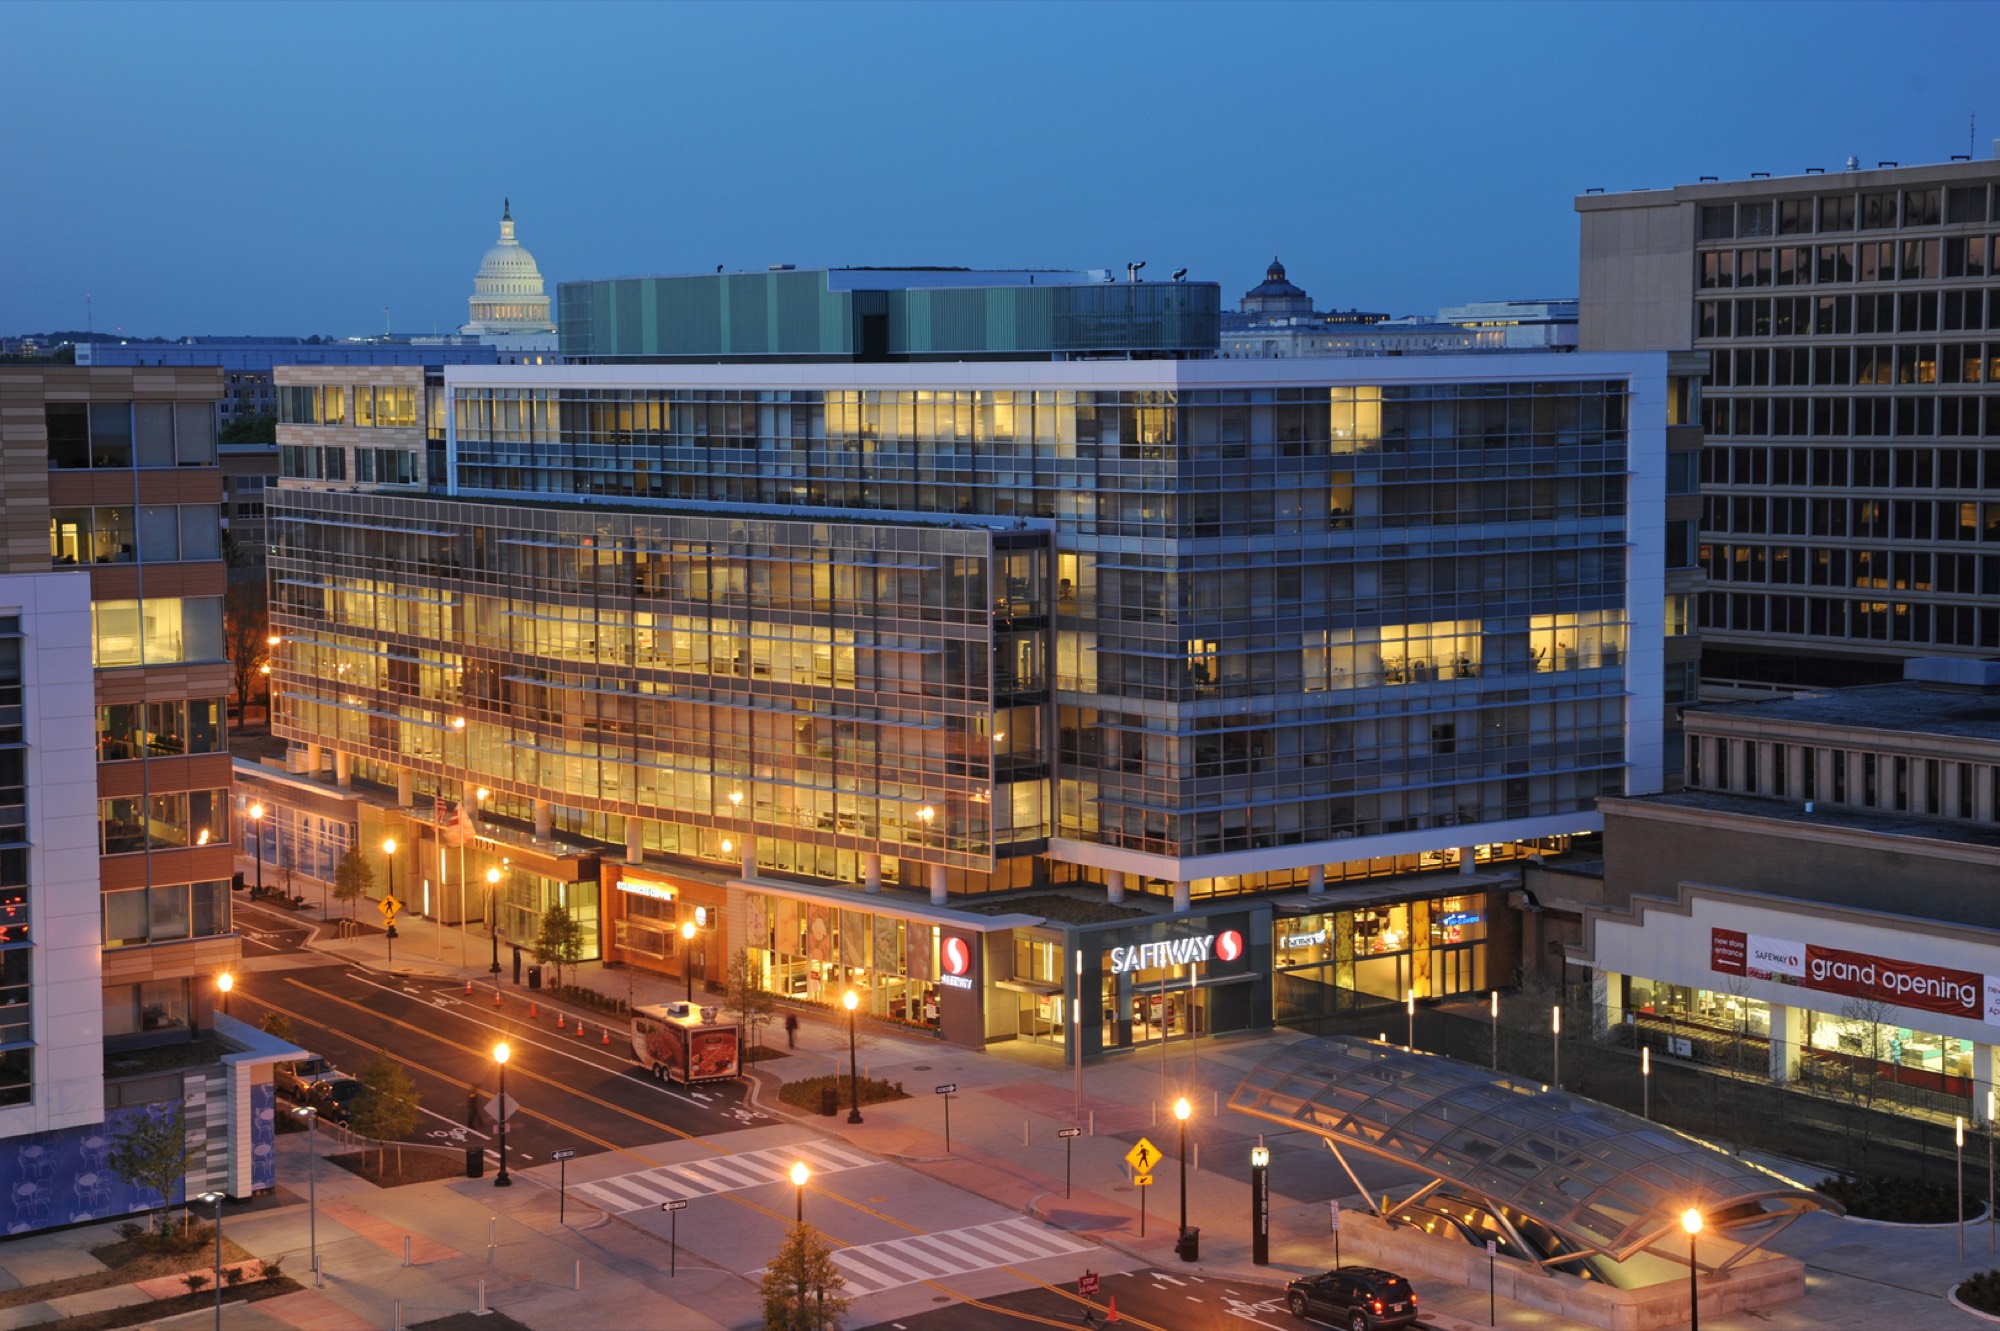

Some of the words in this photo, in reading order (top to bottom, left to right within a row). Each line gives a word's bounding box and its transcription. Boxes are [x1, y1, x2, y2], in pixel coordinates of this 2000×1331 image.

[1728, 940, 1745, 948] store
[1714, 947, 1744, 958] entrance
[1754, 949, 1788, 964] SAFEWAY
[1811, 958, 1875, 986] grand
[1882, 976, 1976, 1008] opening
